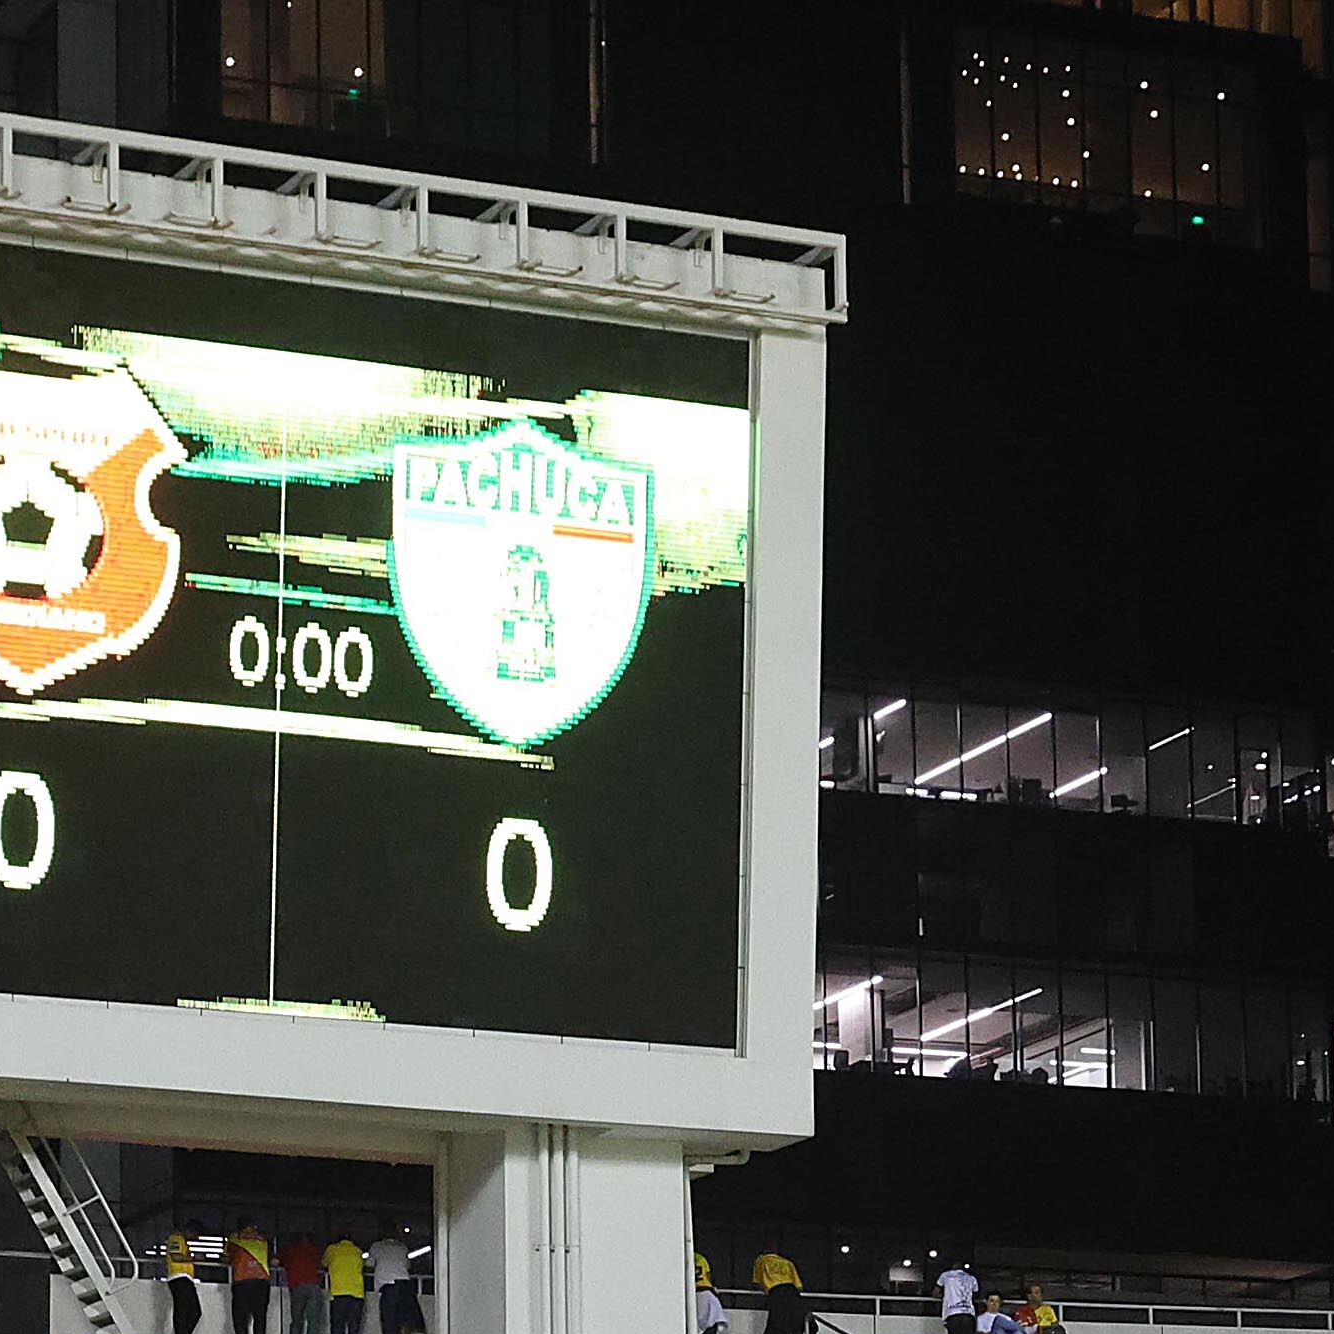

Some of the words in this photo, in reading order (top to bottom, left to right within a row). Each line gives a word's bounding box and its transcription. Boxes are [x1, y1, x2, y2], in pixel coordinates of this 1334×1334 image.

[406, 454, 636, 527] PACHUCA
[229, 615, 374, 697] 0:00
[485, 816, 554, 932] 0
